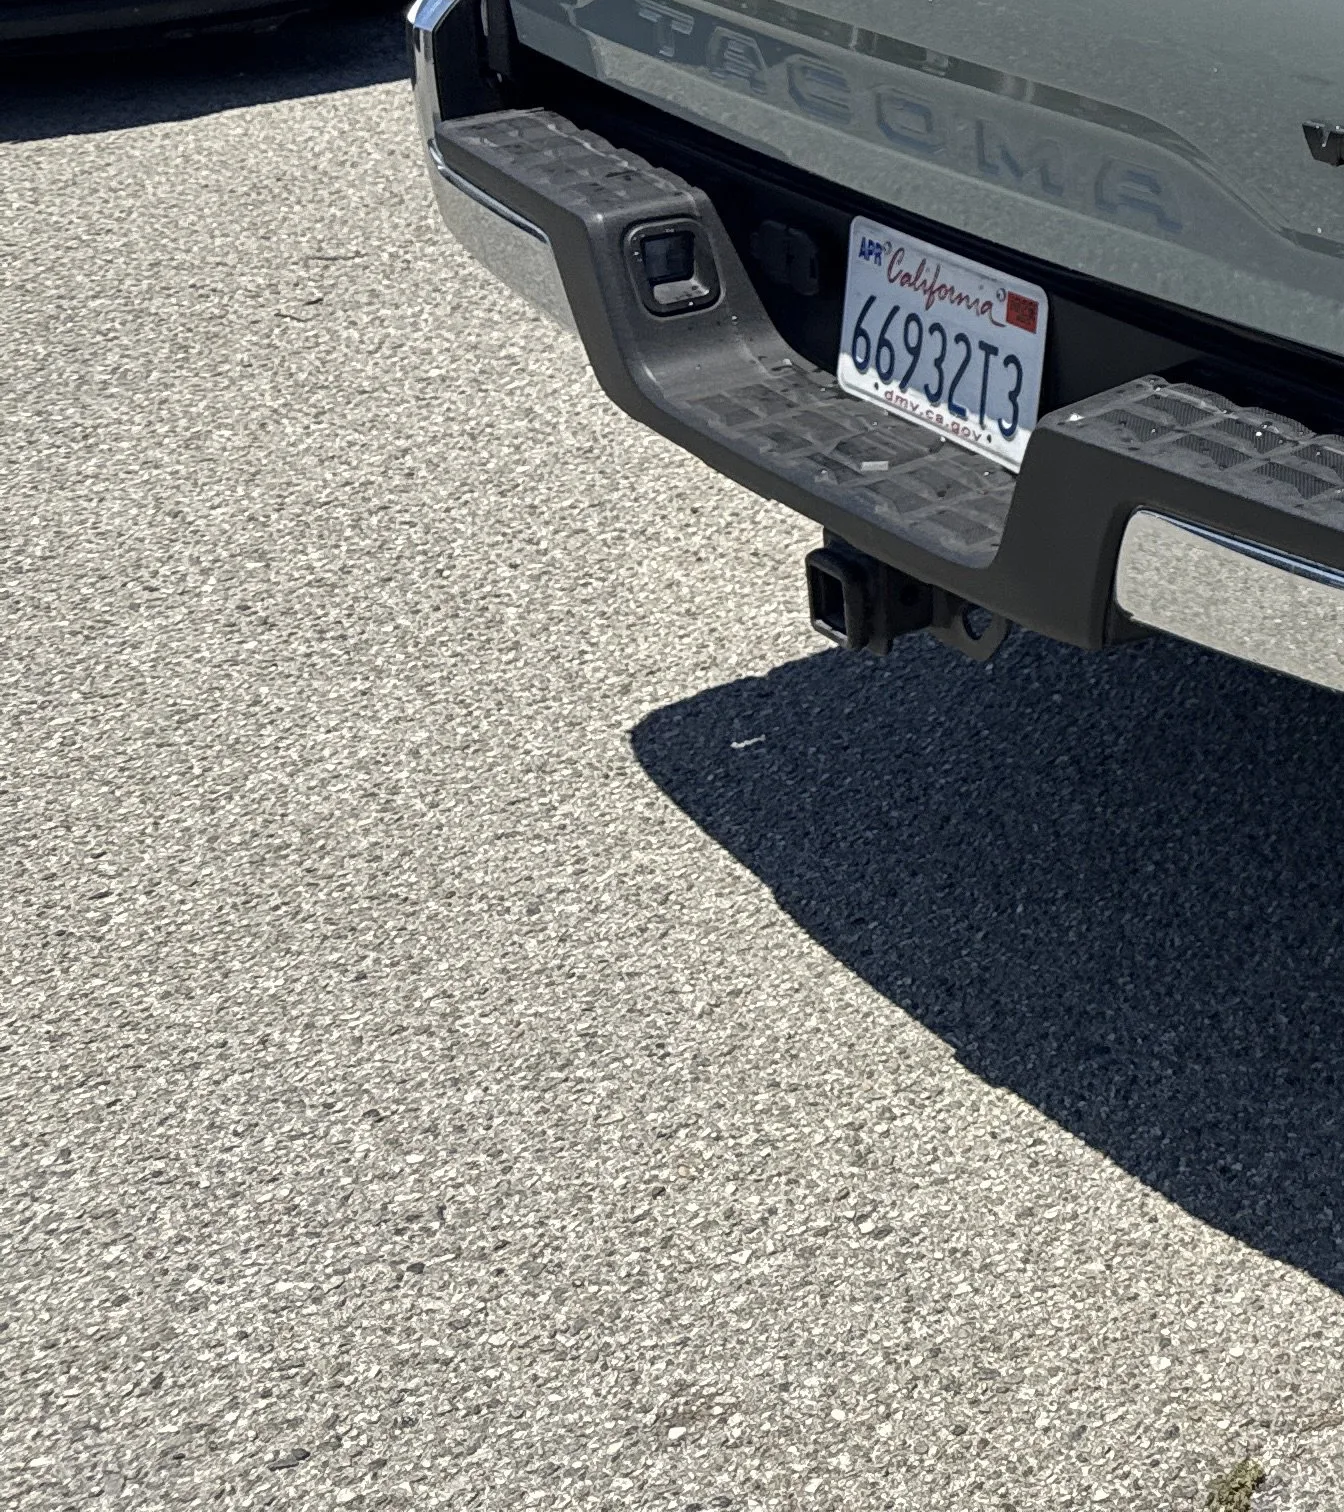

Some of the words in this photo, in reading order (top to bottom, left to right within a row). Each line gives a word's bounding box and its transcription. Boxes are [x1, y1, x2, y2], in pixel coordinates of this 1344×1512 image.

[858, 236, 883, 267] APR
[886, 246, 1006, 328] California
[851, 294, 1024, 440] 66932T3
